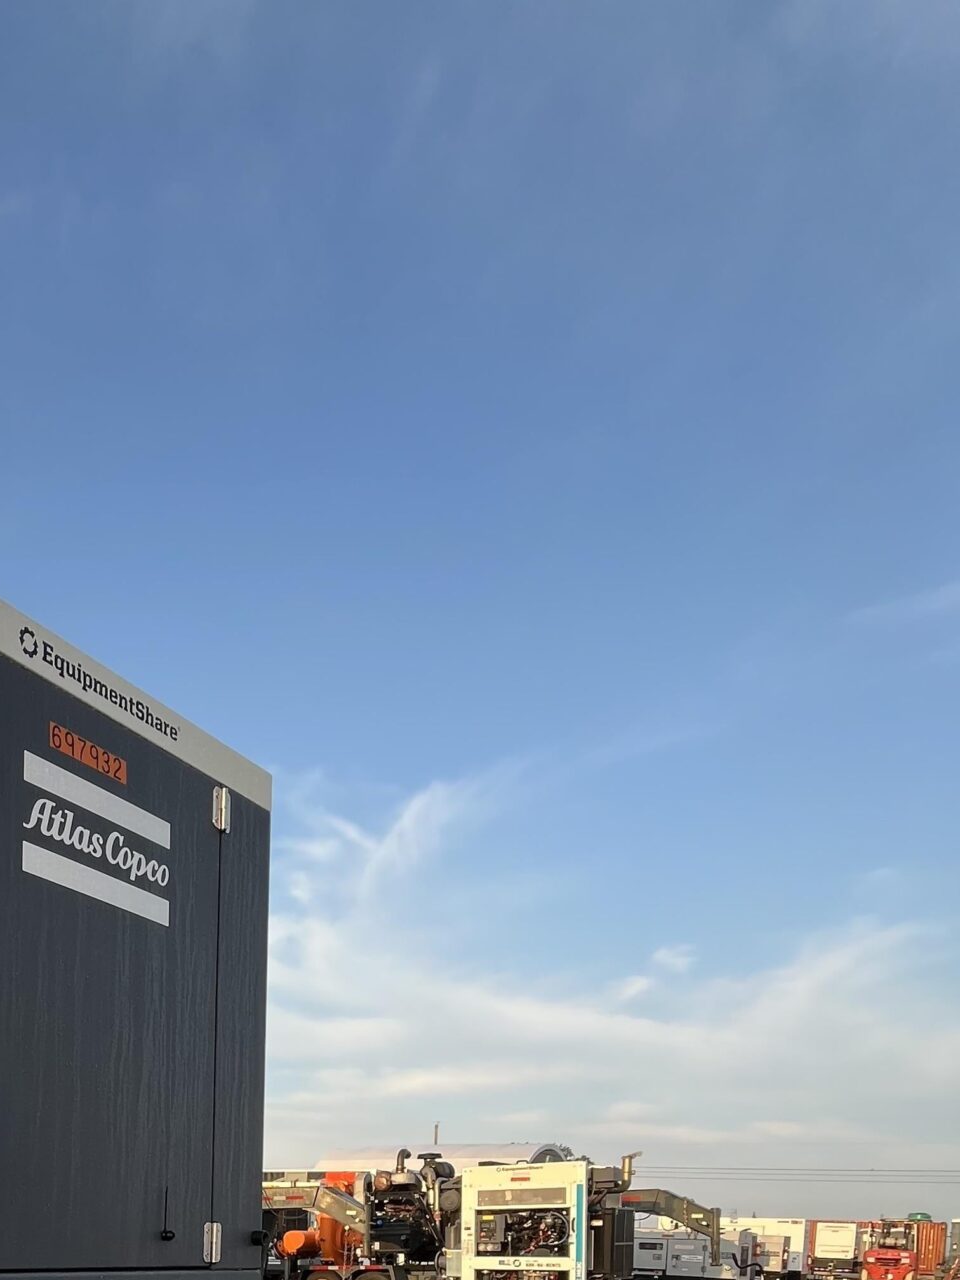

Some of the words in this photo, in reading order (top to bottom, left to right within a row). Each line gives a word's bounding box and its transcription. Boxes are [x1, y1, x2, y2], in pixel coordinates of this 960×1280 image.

[42, 640, 178, 741] EquipmentShare
[51, 724, 122, 781] 697932
[22, 798, 104, 858] Atlas
[105, 831, 170, 887] Copco
